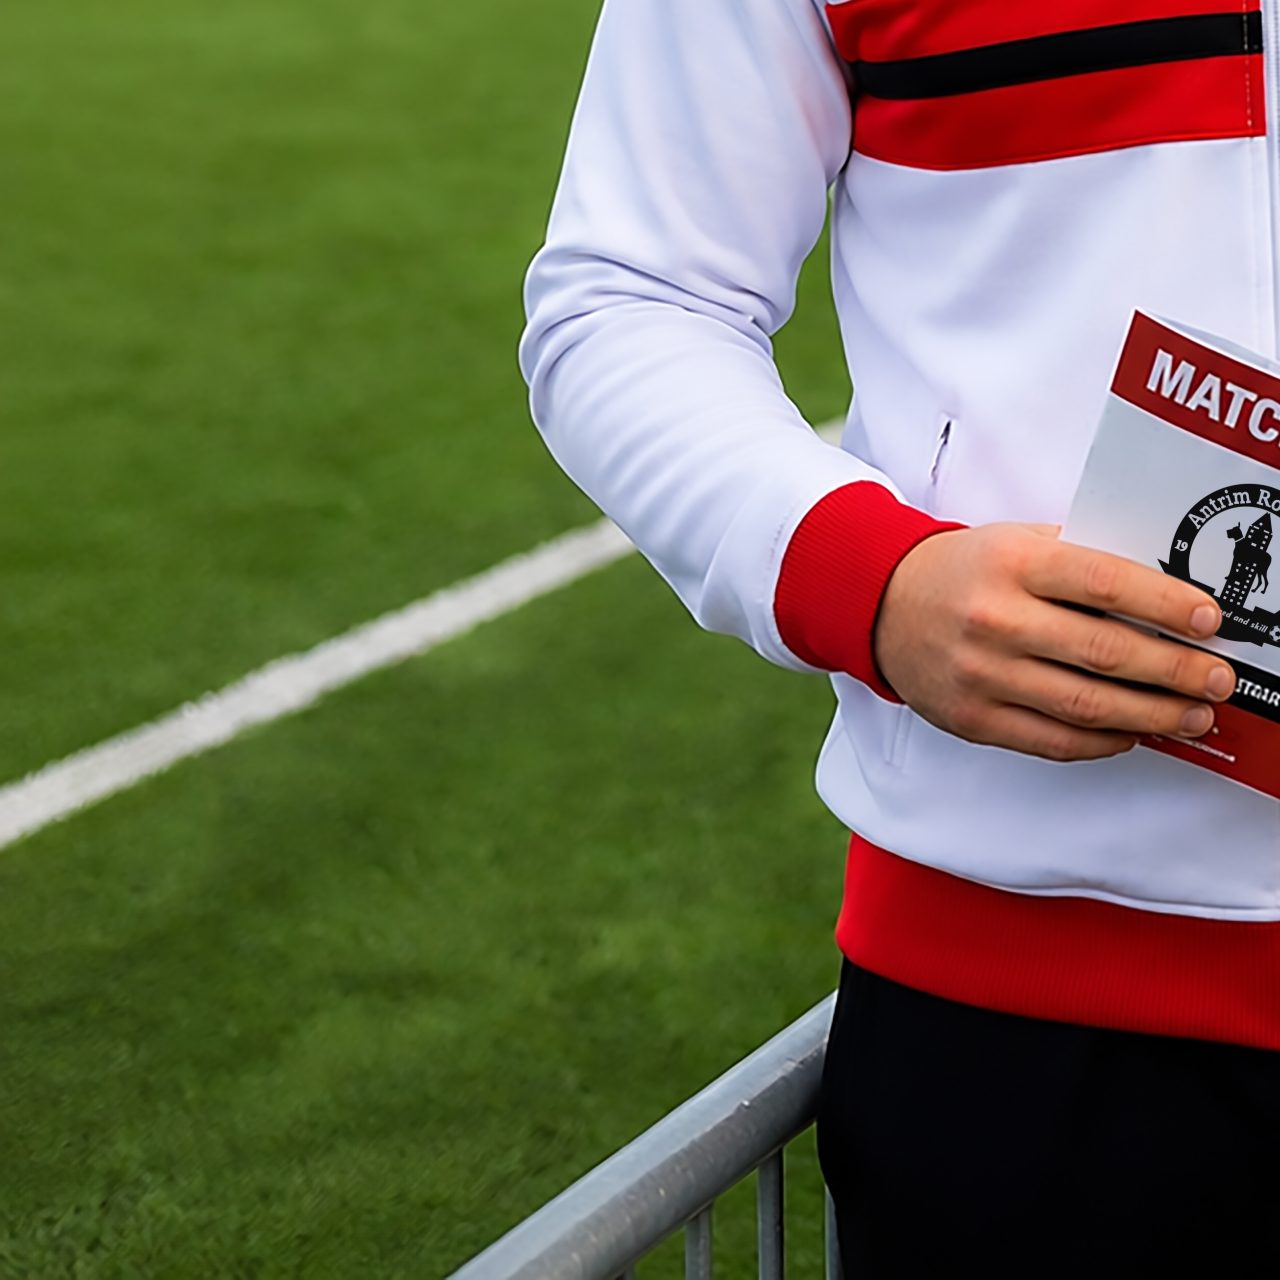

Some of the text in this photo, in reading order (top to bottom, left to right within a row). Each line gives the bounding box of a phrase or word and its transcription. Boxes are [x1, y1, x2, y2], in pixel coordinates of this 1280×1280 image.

[1187, 489, 1251, 530] Antrim
[1174, 539, 1189, 552] 19
[1233, 615, 1269, 634] and skill
